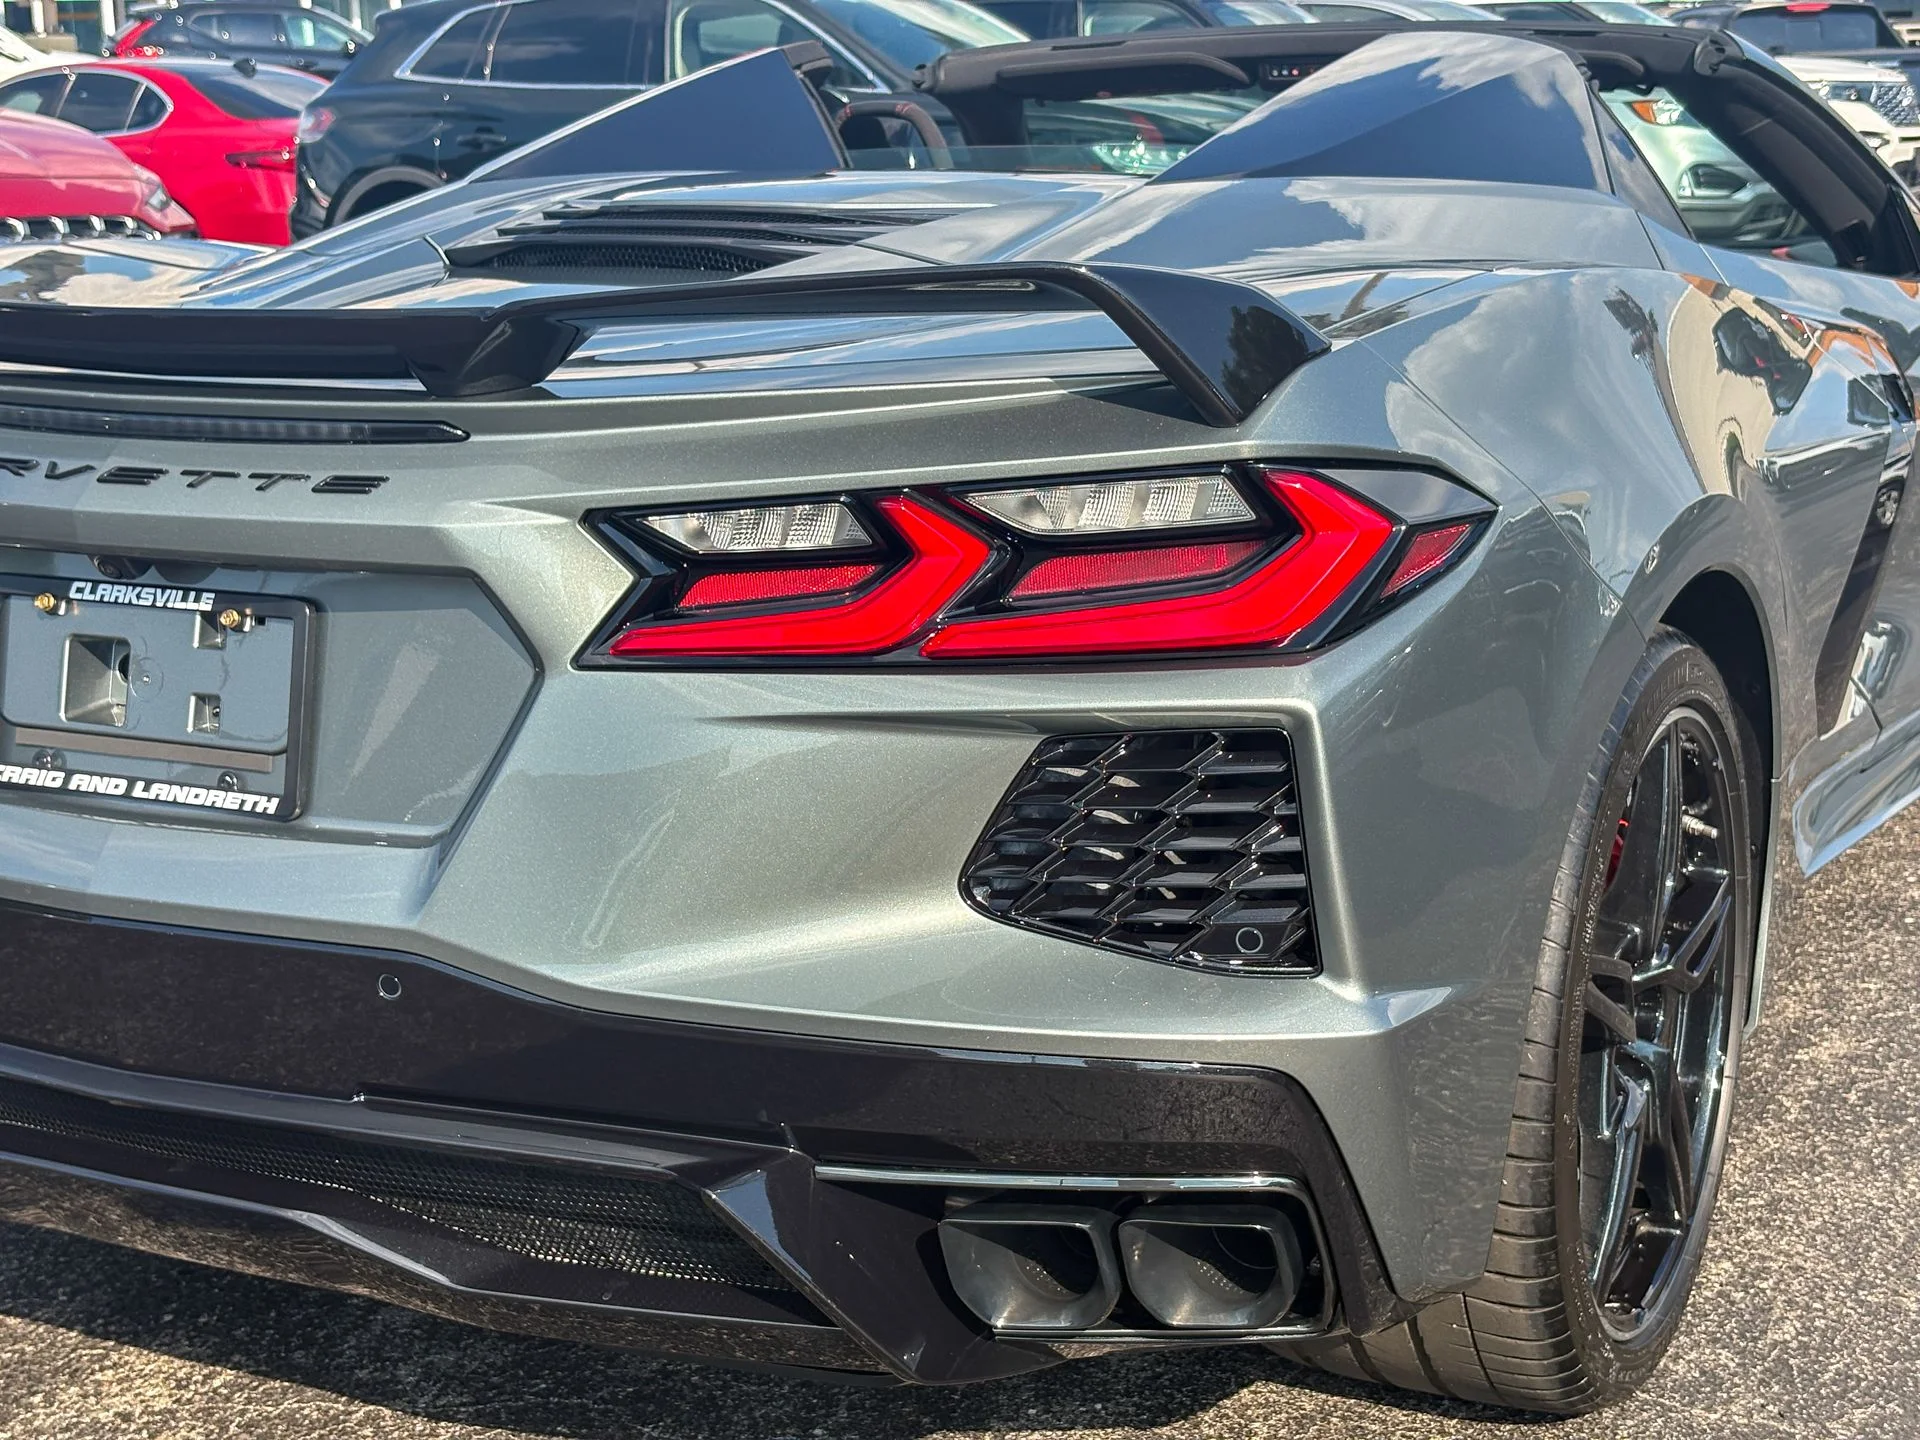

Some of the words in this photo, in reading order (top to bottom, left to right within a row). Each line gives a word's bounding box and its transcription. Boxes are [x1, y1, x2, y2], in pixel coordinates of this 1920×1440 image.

[69, 581, 216, 612] CLARKSVILLE
[68, 773, 129, 796] AND
[131, 780, 280, 815] LANDRETH
